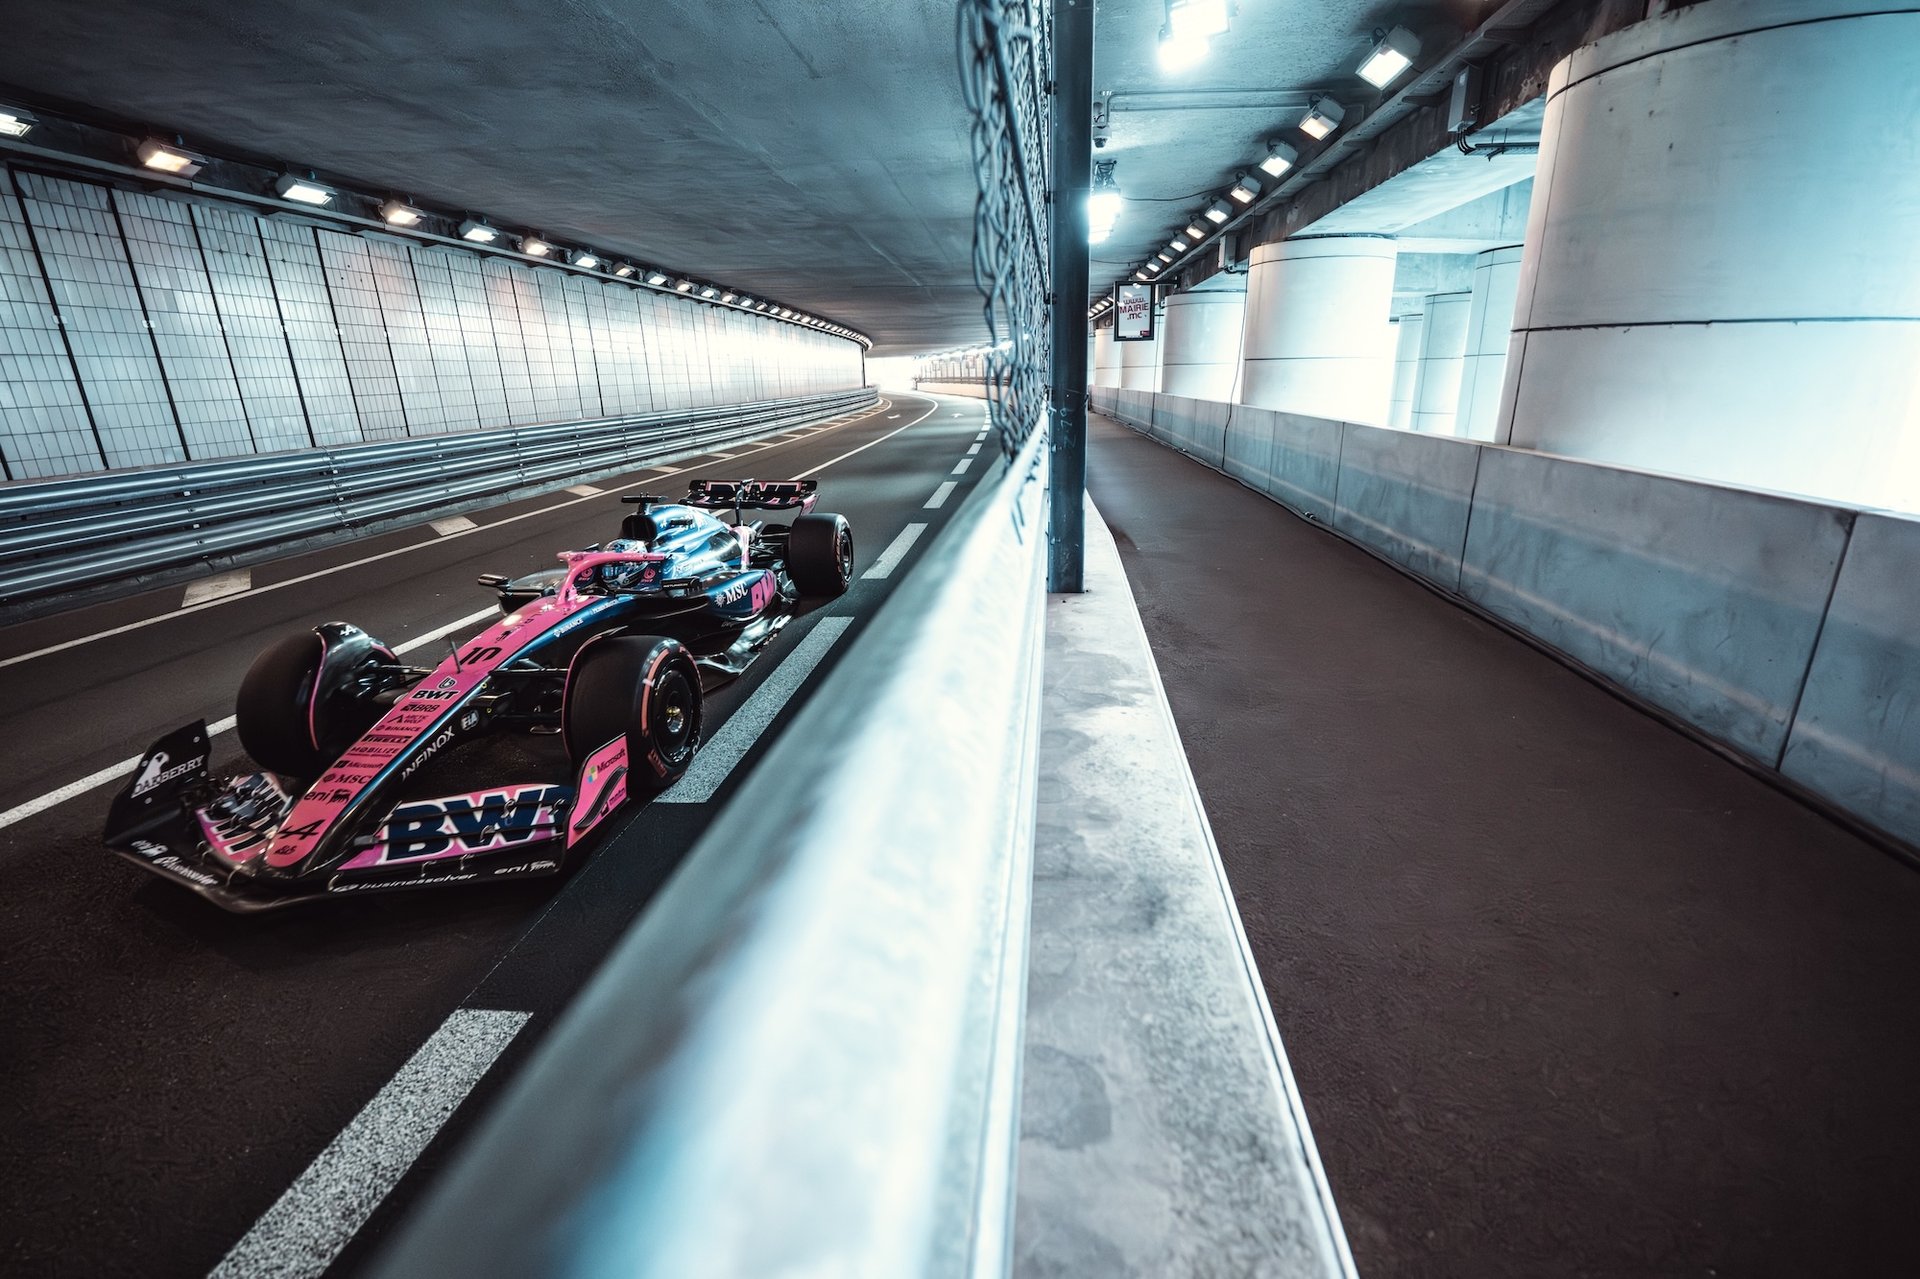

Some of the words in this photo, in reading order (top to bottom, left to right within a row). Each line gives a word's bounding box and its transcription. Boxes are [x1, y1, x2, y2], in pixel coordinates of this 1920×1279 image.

[1119, 303, 1149, 313] MAIRIE
[1127, 312, 1142, 320] .mc
[725, 581, 749, 605] MSC
[460, 647, 502, 665] 10
[411, 689, 460, 700] BWT
[461, 712, 478, 729] FIA
[401, 725, 456, 782] INFINOX
[597, 748, 626, 773] Microsoft
[337, 774, 372, 784] MSC
[303, 789, 335, 801] eni
[494, 863, 527, 875] eni
